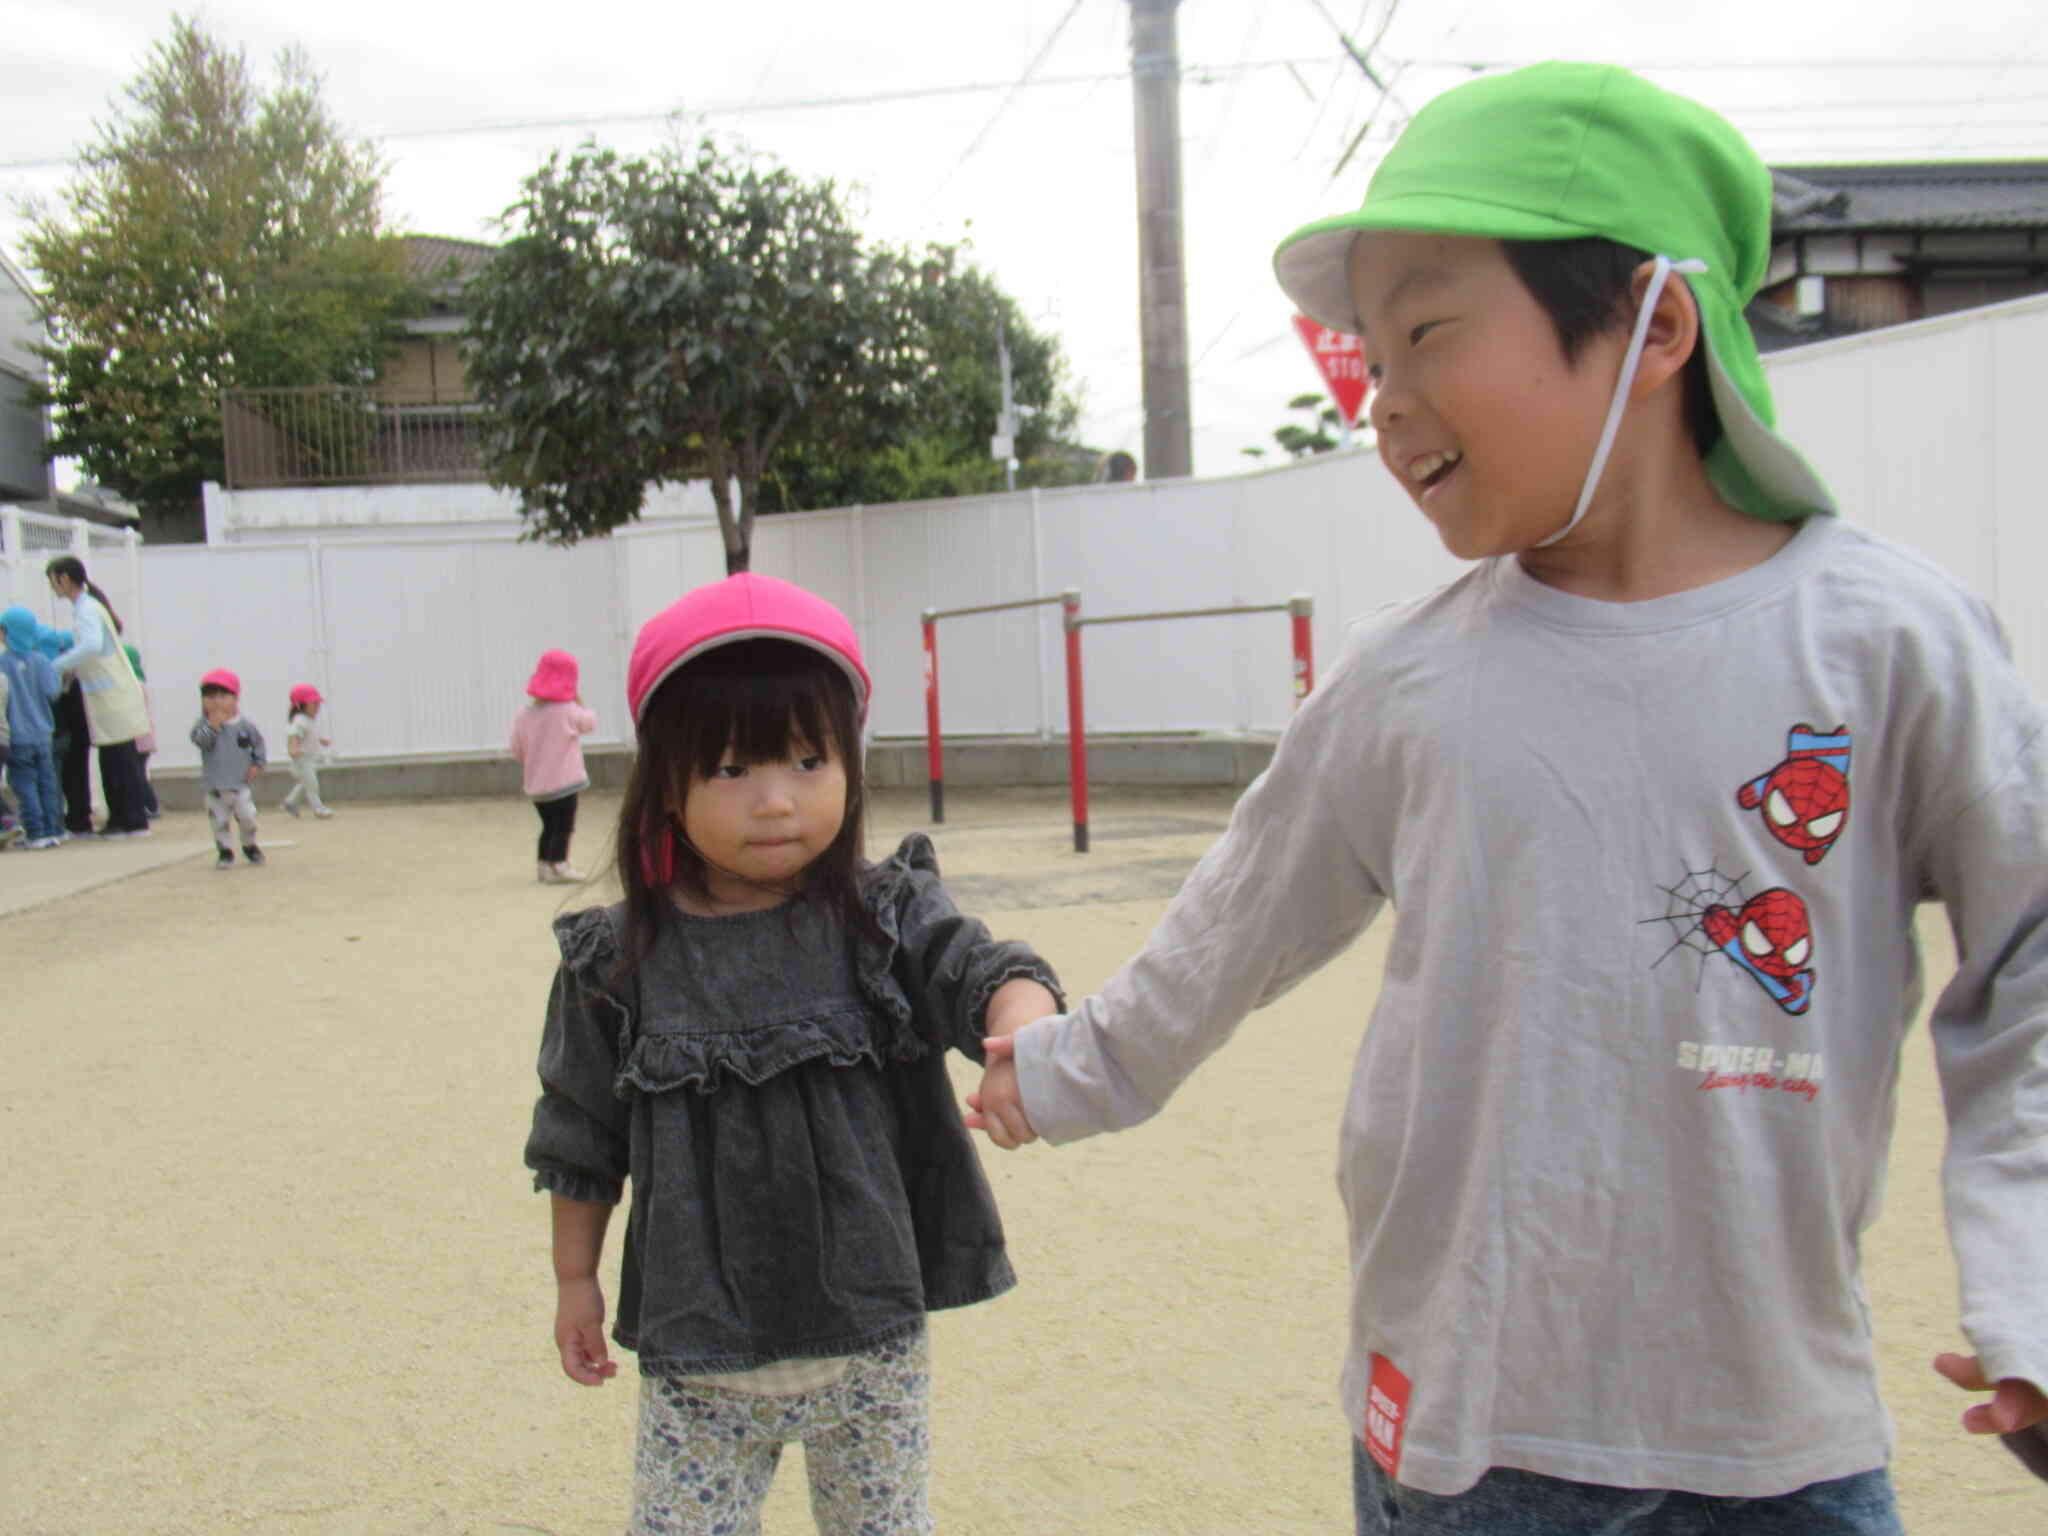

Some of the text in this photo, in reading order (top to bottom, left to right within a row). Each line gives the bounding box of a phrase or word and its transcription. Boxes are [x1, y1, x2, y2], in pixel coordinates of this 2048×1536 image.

[1316, 329, 1361, 352] 止ま
[1328, 357, 1365, 379] STO
[1677, 1041, 1826, 1080] SPIDER-MA
